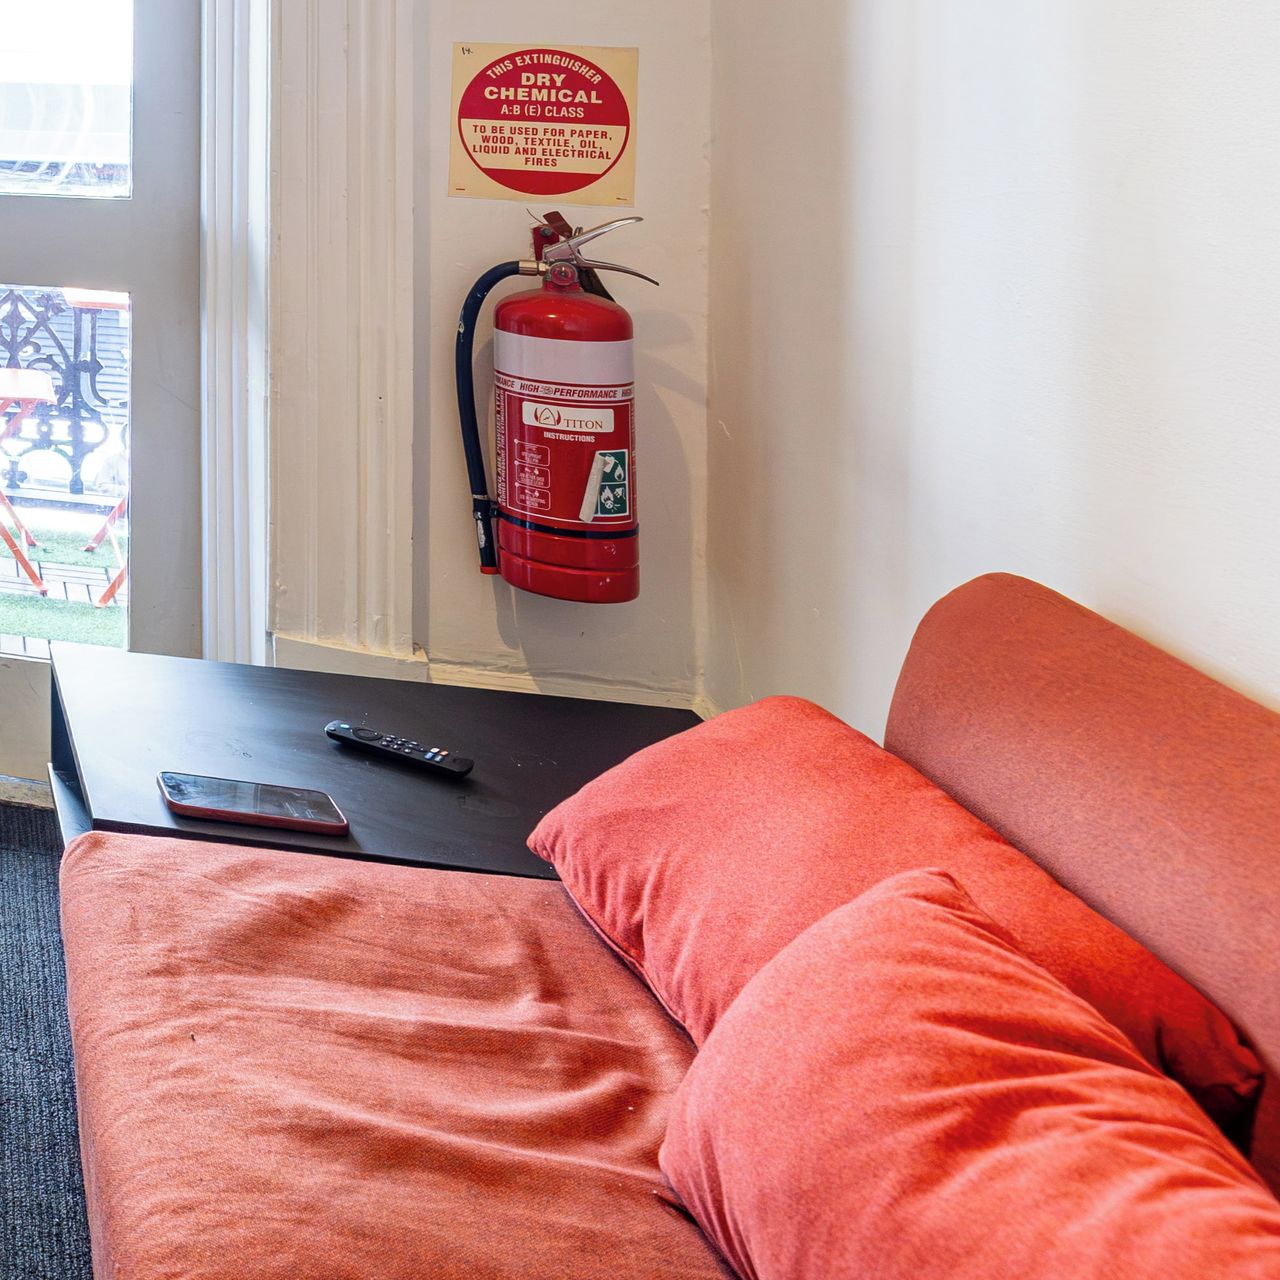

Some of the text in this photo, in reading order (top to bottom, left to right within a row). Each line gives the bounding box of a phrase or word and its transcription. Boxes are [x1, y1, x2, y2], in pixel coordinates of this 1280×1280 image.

[485, 53, 604, 85] THIS EXTINGUISHER
[521, 72, 567, 87] DRY
[483, 86, 604, 105] CHEMICAL
[500, 104, 585, 119] A:B (E) CLASS
[472, 124, 613, 141] TO BE USED FOR PAPER,
[481, 135, 603, 150] WOOD, TEXTILE, OIL,
[472, 145, 612, 160] LIQUID AND ELECTRICAL
[524, 157, 558, 167] FIRES
[519, 382, 540, 393] HIGH
[553, 387, 618, 399] PERFORMANCE
[563, 418, 603, 430] TITON
[543, 431, 596, 443] INSTRUCTIONS
